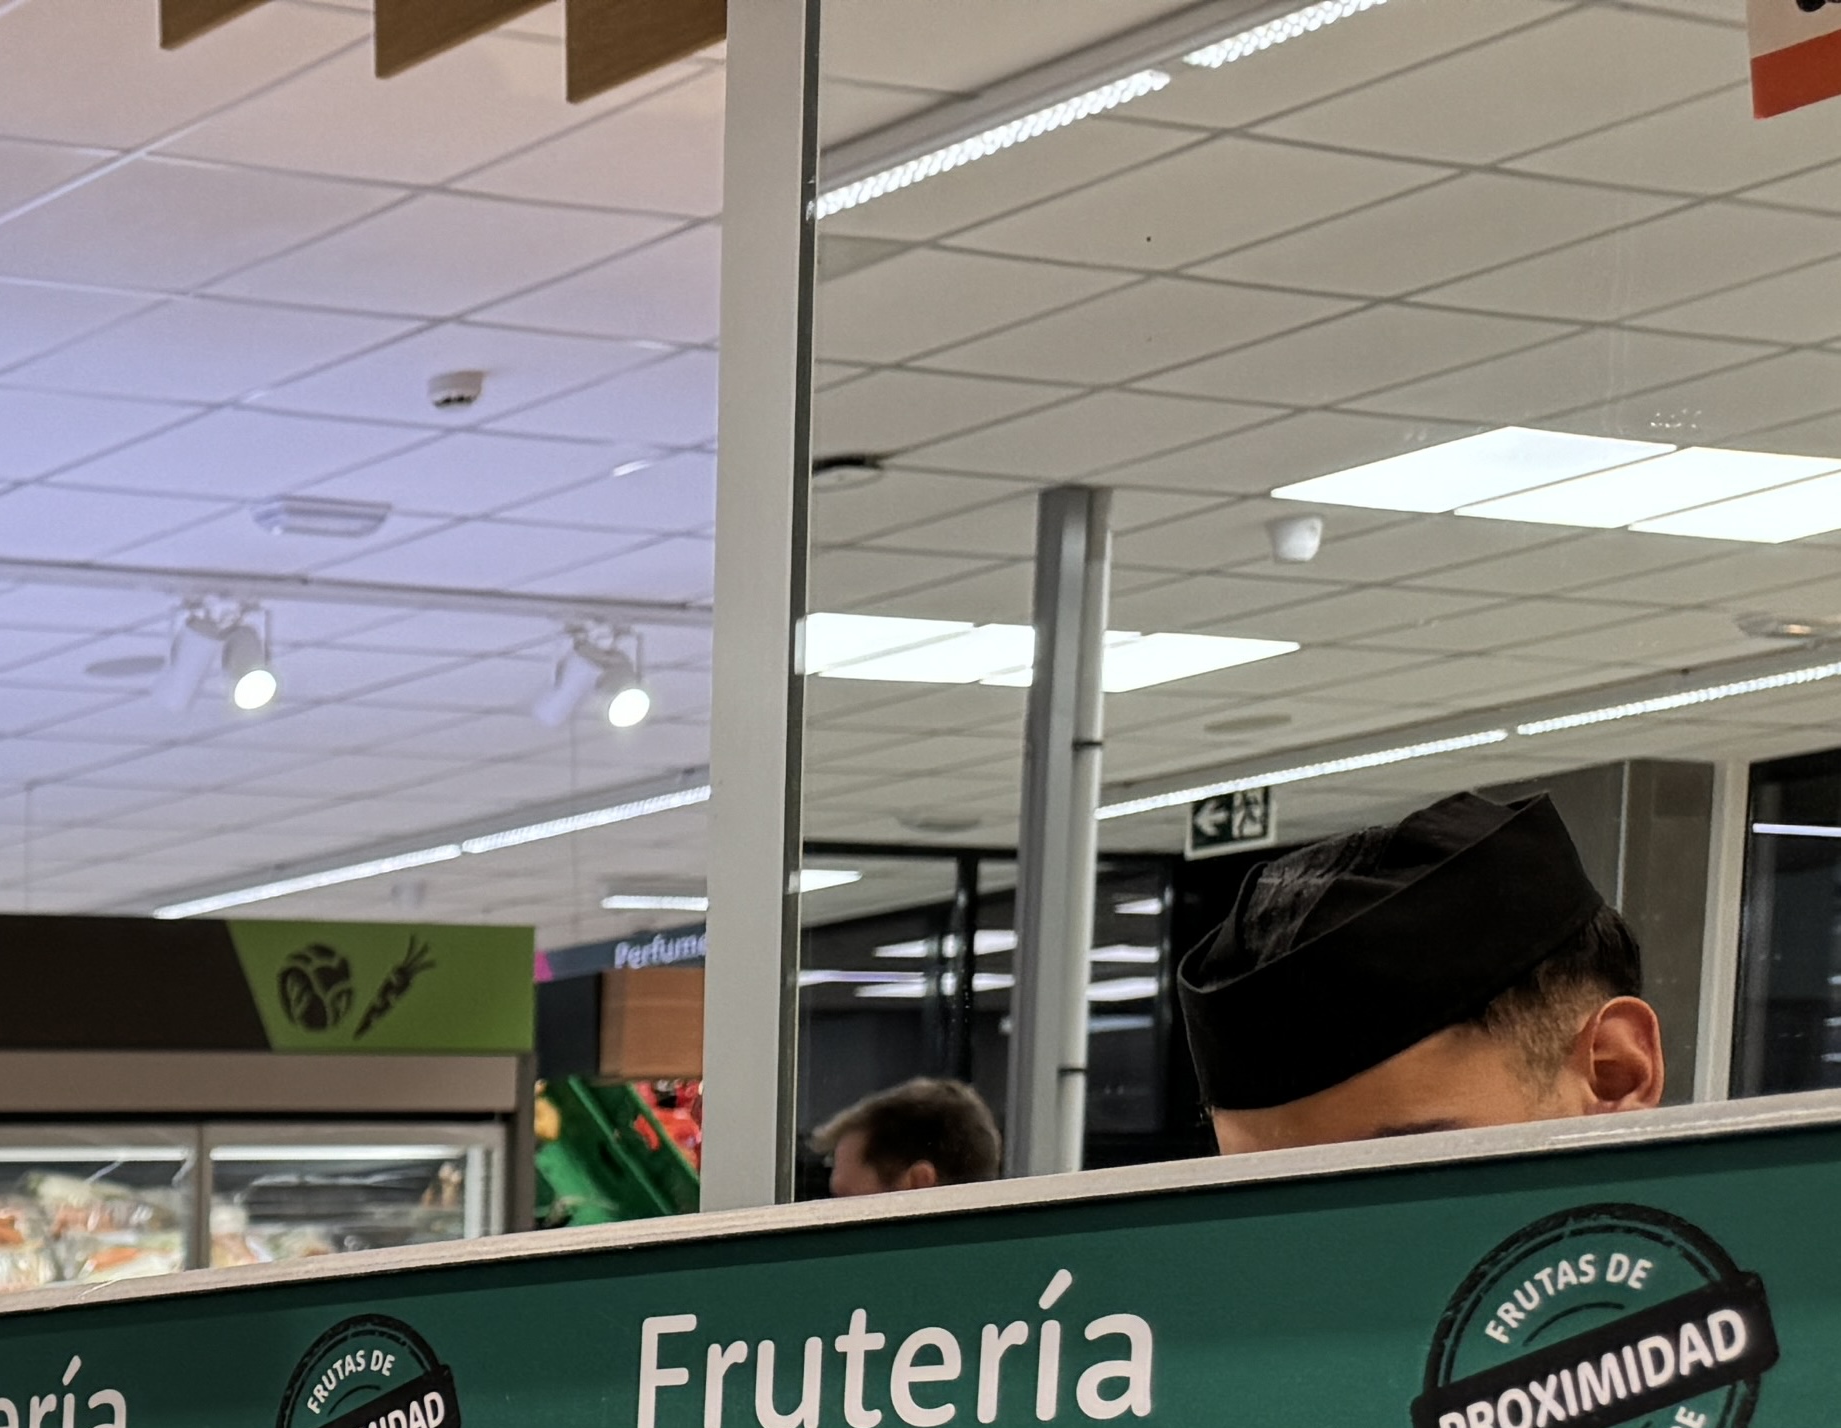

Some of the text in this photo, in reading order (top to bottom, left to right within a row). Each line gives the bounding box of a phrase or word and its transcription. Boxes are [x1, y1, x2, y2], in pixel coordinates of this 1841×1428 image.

[1485, 1253, 1655, 1346] FRUTAS DE
[306, 1348, 395, 1414] FRUTAS DE
